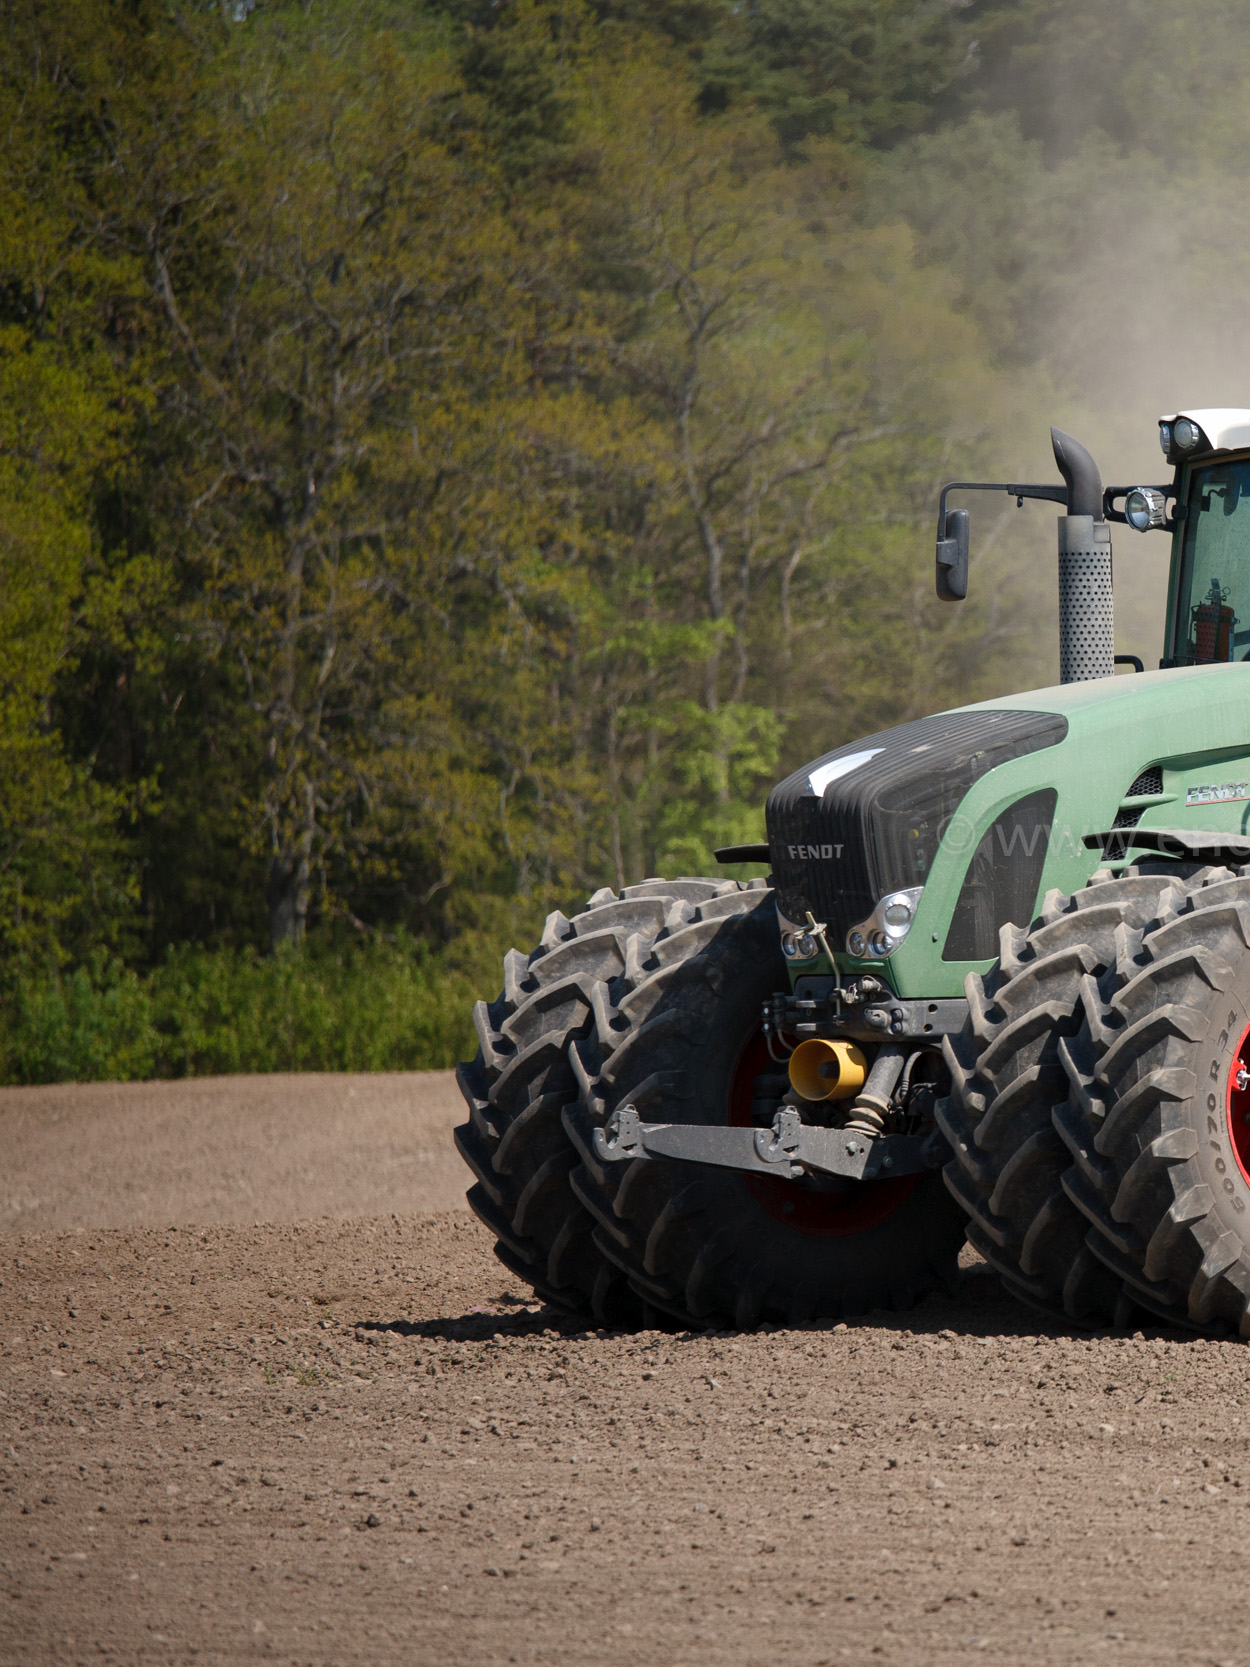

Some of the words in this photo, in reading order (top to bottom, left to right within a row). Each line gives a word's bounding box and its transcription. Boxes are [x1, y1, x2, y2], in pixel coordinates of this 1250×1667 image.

[1186, 780, 1248, 803] FENDT
[787, 844, 844, 859] FENDT
[1209, 1058, 1222, 1083] R
[1216, 1009, 1239, 1052] 34
